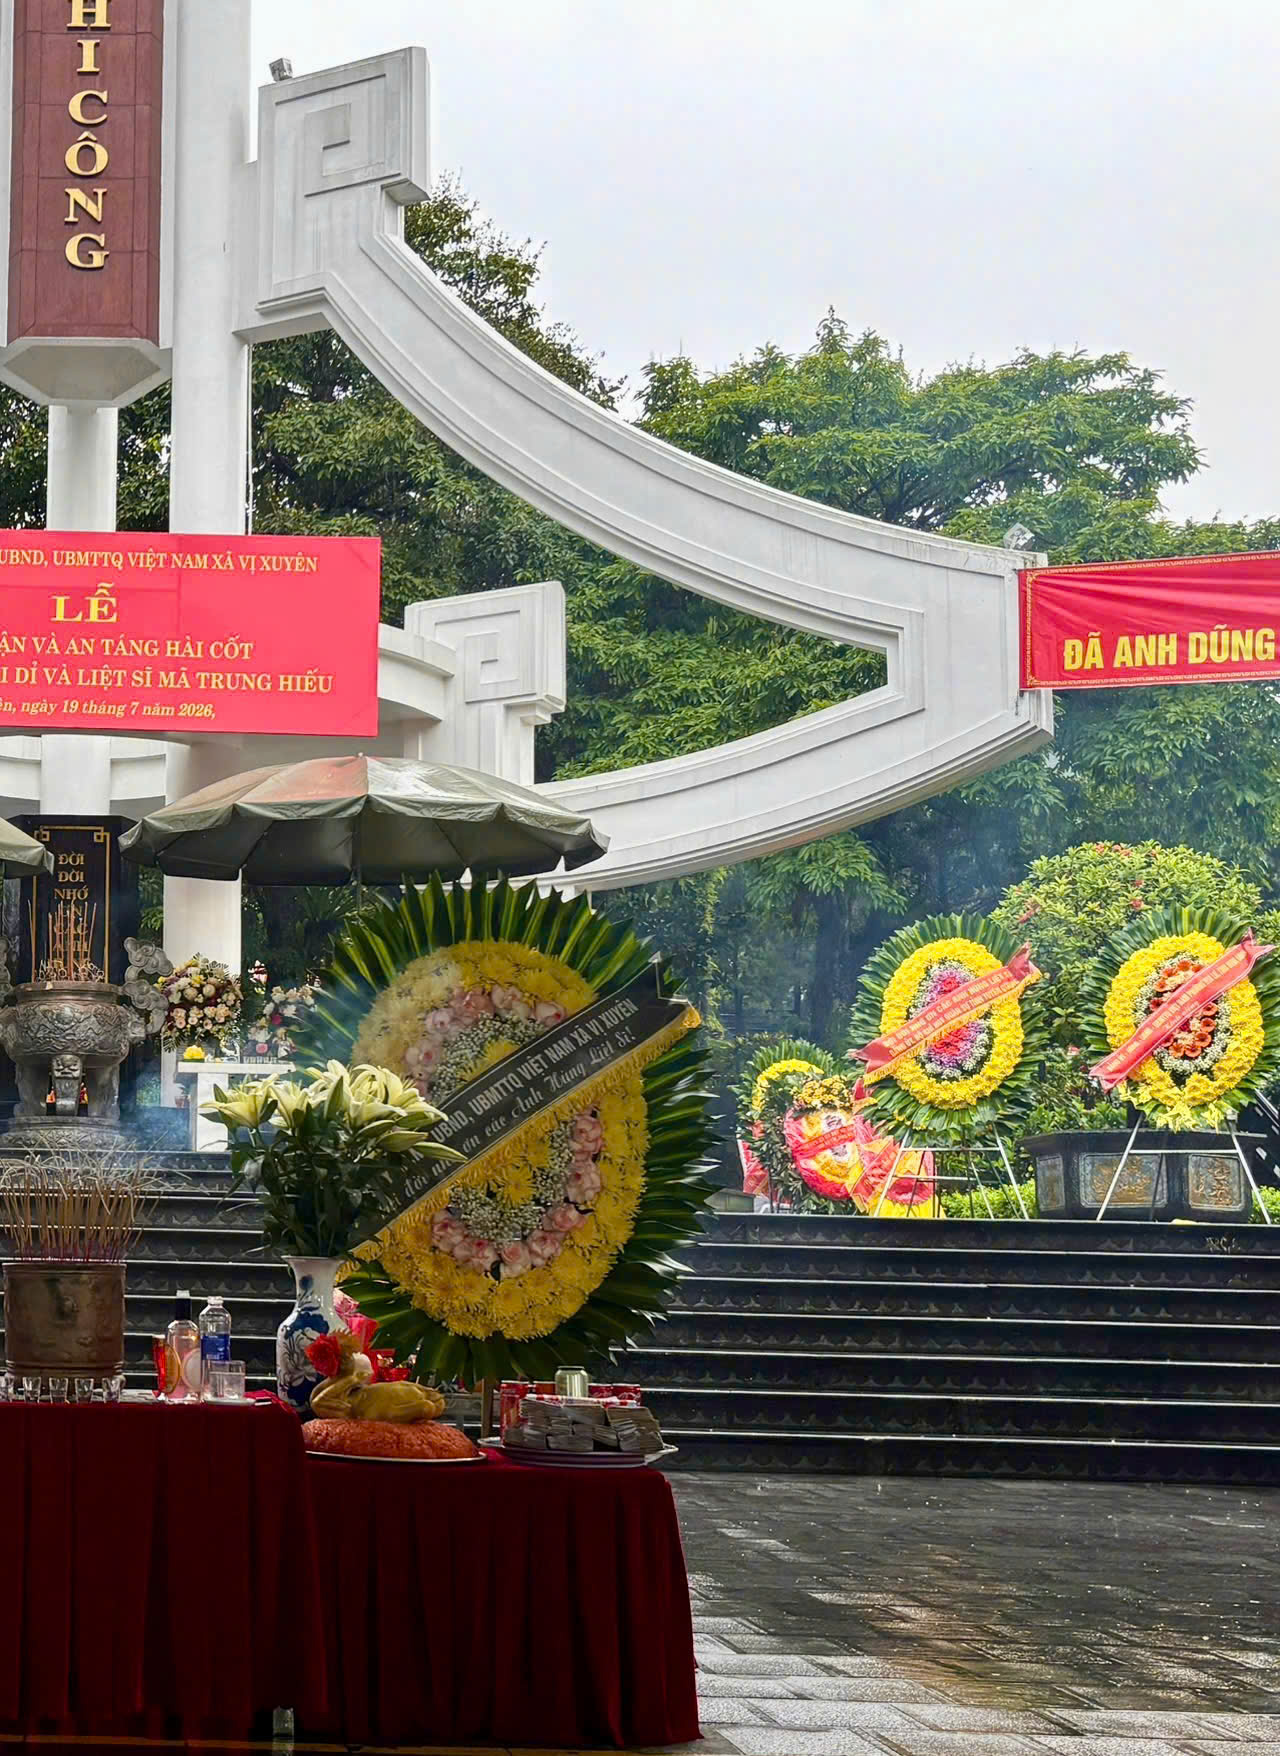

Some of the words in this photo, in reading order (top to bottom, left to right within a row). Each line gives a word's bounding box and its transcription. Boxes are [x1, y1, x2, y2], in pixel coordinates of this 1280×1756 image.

[64, 89, 110, 268] CÔNG
[52, 550, 123, 571] UBMTTQ
[127, 548, 167, 572] VIỆT
[170, 552, 209, 570] NAM
[211, 550, 235, 571] XÃ
[238, 554, 256, 575] VỊ
[259, 552, 319, 572] XUYÊN
[50, 581, 118, 623] LỄ
[31, 632, 61, 655] VÀ
[65, 637, 95, 656] AN
[100, 633, 159, 657] TÁNG
[165, 635, 204, 659] HÀI
[209, 633, 254, 660] CỐT
[1063, 631, 1105, 671] ĐÃ
[1112, 633, 1178, 668] ANH
[1187, 623, 1276, 664] DŨNG
[13, 660, 38, 685] DỈ
[43, 663, 72, 686] VÀ
[77, 664, 127, 691] LIỆT
[131, 665, 153, 688] SĨ
[158, 666, 191, 689] MÃ
[196, 671, 272, 692] TRUNG
[278, 667, 334, 693] HIẾU
[20, 699, 58, 716] ngày
[62, 699, 79, 714] 19
[82, 700, 126, 717] tháng
[130, 701, 140, 715] 7
[142, 701, 175, 716] năm
[178, 702, 216, 719] 2026,
[58, 851, 85, 866] ĐỜI
[58, 868, 85, 883] ĐỜI
[54, 885, 89, 900] NHỚ
[430, 1110, 476, 1144] UBND,
[468, 1072, 525, 1116] UBMTTQ
[517, 1053, 549, 1080] VIỆT
[543, 1036, 577, 1063] NAM
[569, 1024, 593, 1047] XÃ
[585, 1018, 608, 1036] VỊ
[598, 998, 639, 1029] XUYÊN
